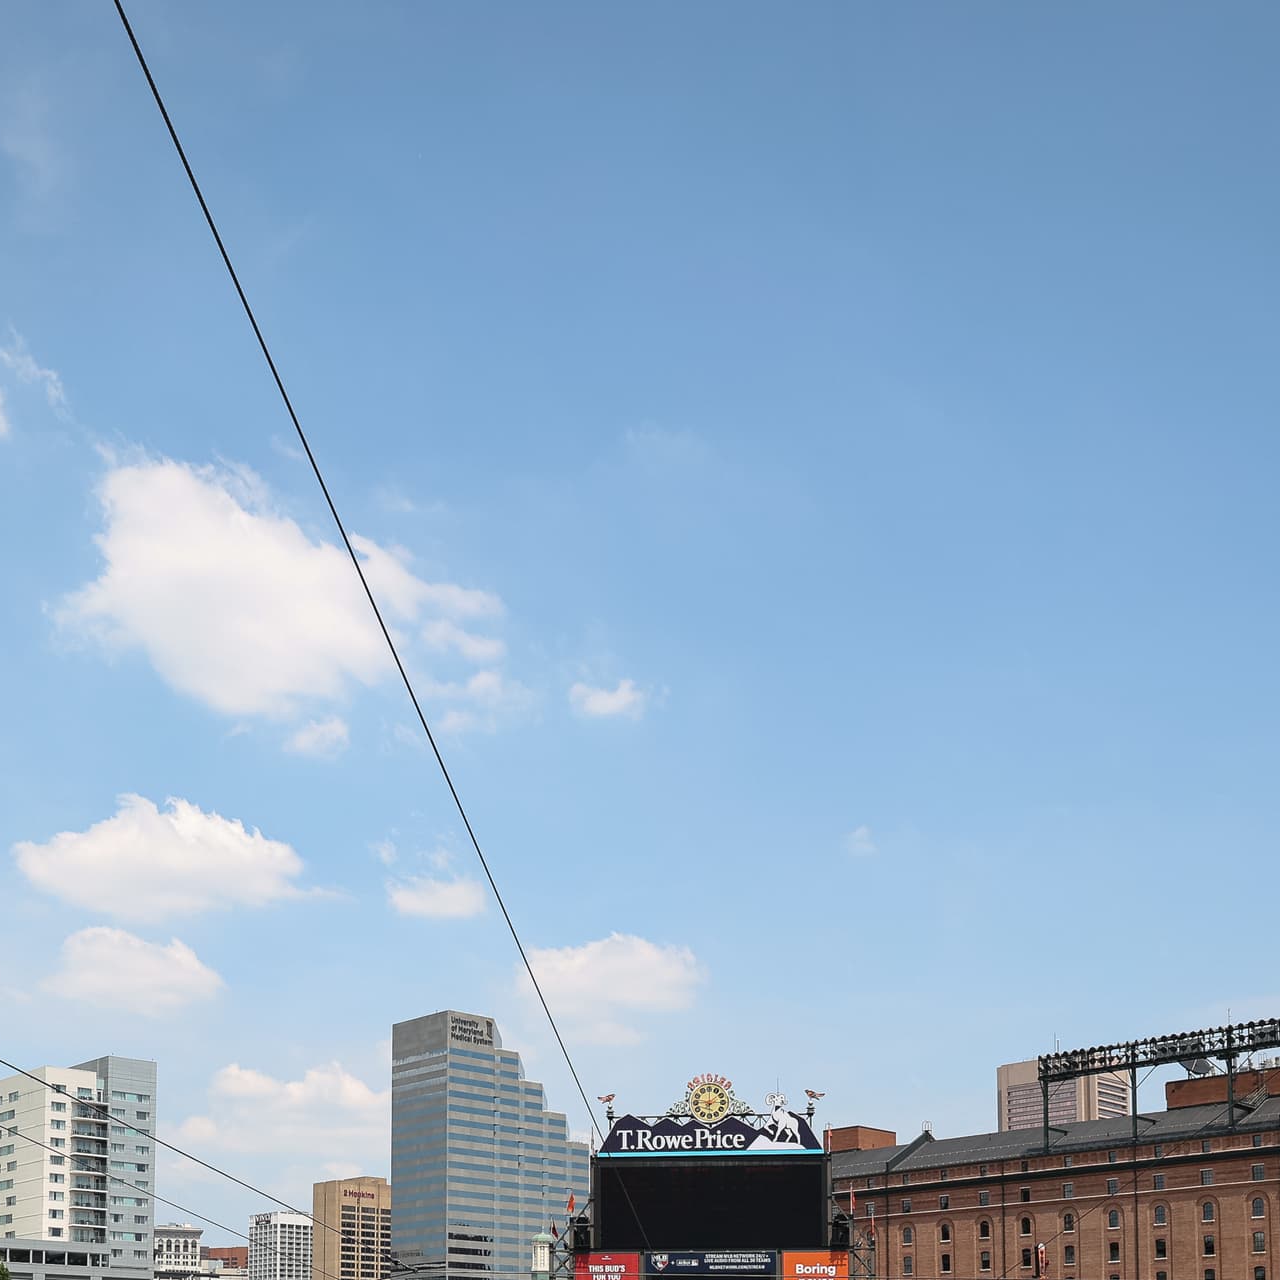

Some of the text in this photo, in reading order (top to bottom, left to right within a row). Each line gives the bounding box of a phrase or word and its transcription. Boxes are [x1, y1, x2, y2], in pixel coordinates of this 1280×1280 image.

[451, 1016, 479, 1029] University
[458, 1026, 483, 1037] Maryland
[451, 1032, 493, 1046] Medical System
[349, 1190, 375, 1199] Hopkins
[589, 1265, 626, 1273] THIS BUD'S
[795, 1264, 836, 1276] Boring
